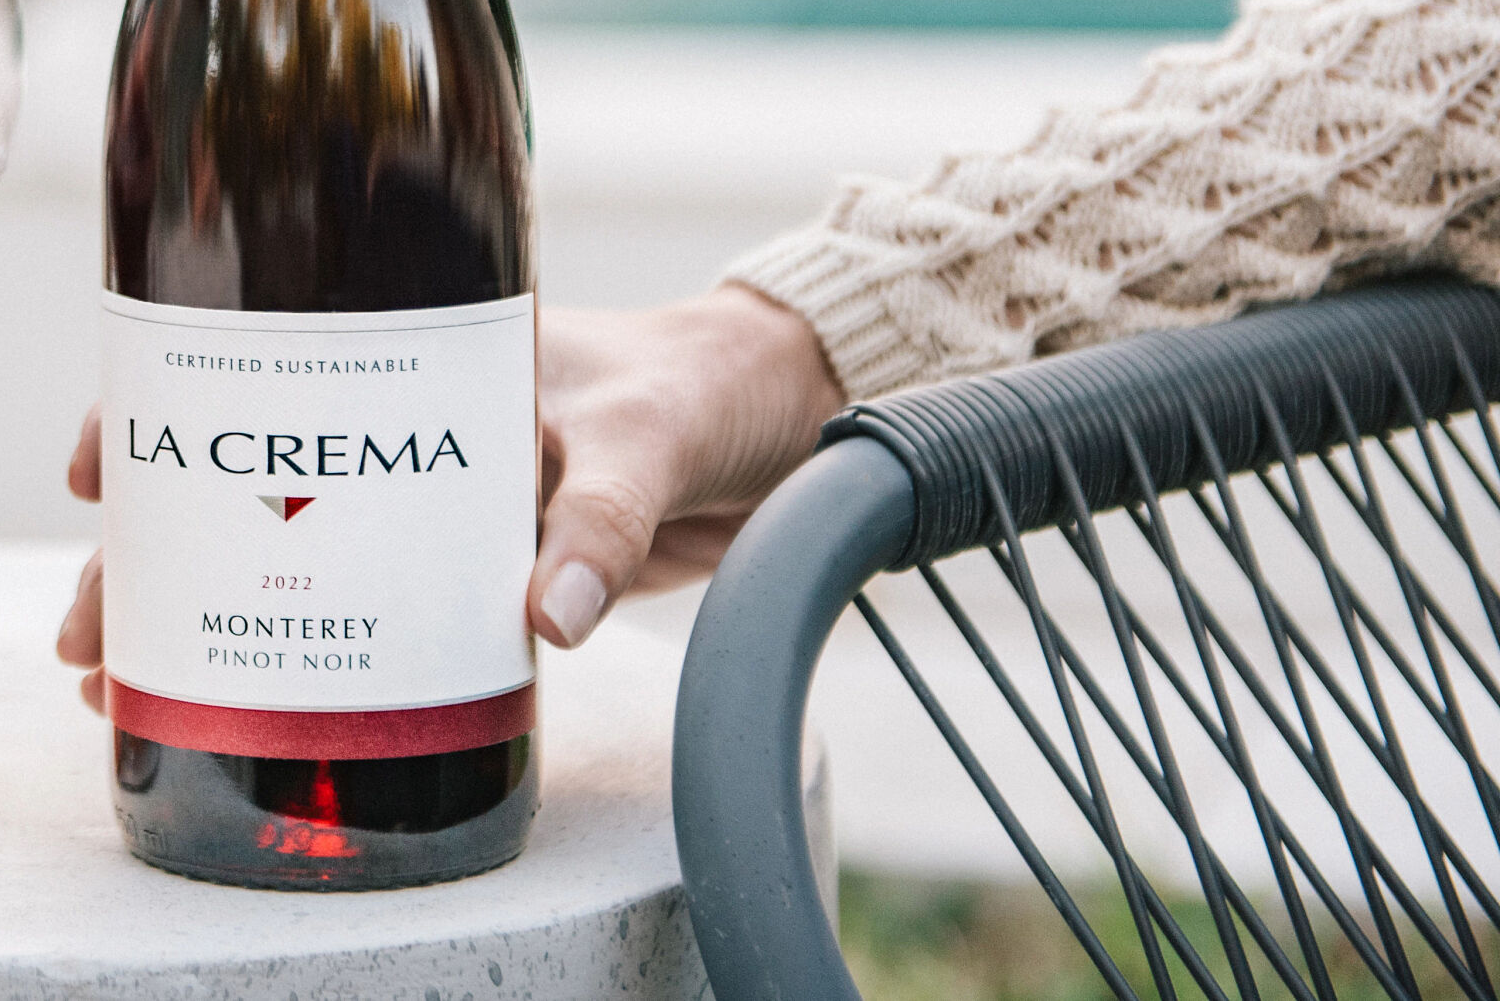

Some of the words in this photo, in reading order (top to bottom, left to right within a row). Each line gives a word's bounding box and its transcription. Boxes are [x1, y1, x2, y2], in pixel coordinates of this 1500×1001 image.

[165, 352, 262, 373] CERTIFIED
[274, 357, 420, 374] SUSTAINABLE
[129, 418, 188, 468] LA
[209, 428, 470, 477] CREMA
[261, 574, 313, 591] 2022
[202, 612, 379, 640] MONTEREY
[208, 647, 287, 669] PINOT
[303, 653, 372, 671] NOIR
